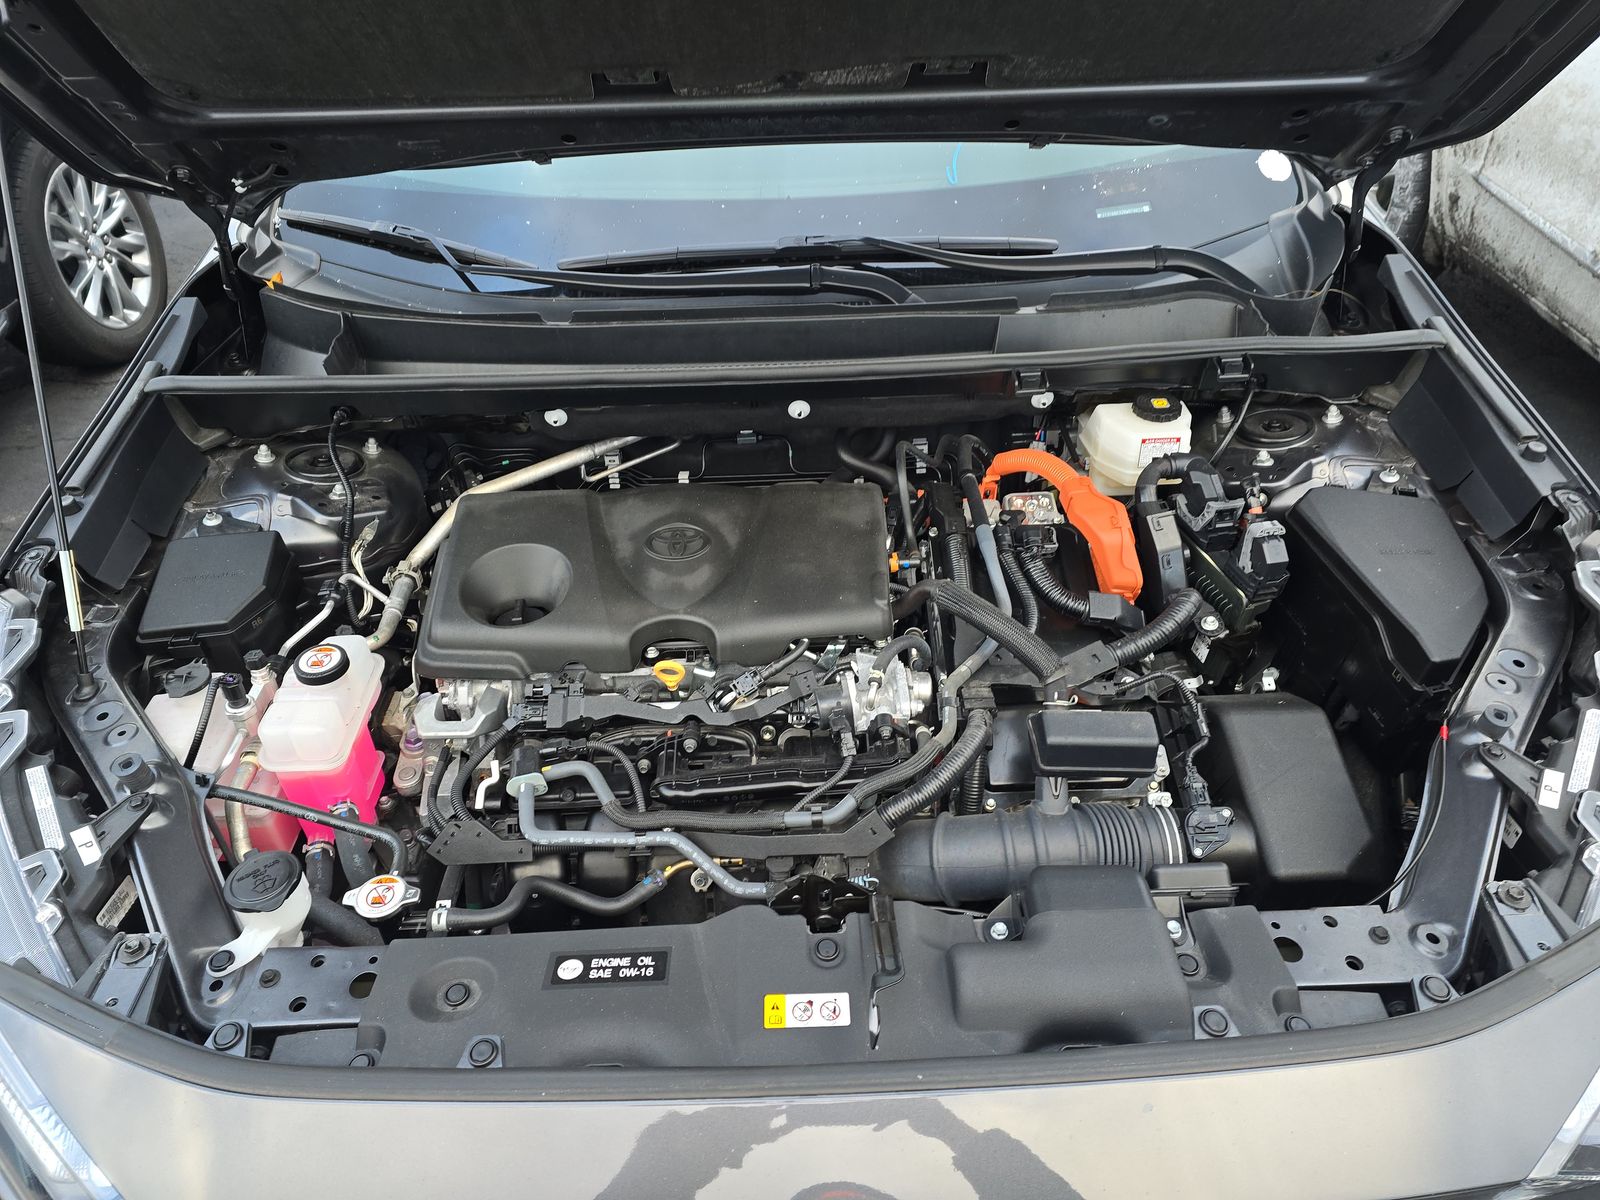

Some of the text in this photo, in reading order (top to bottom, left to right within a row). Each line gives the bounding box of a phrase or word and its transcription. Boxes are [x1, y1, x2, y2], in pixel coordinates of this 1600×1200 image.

[1543, 784, 1559, 793] P
[78, 840, 94, 848] P
[590, 956, 655, 968] ENGINE OIL
[588, 968, 613, 979] SAE
[619, 967, 654, 978] 0W-16
